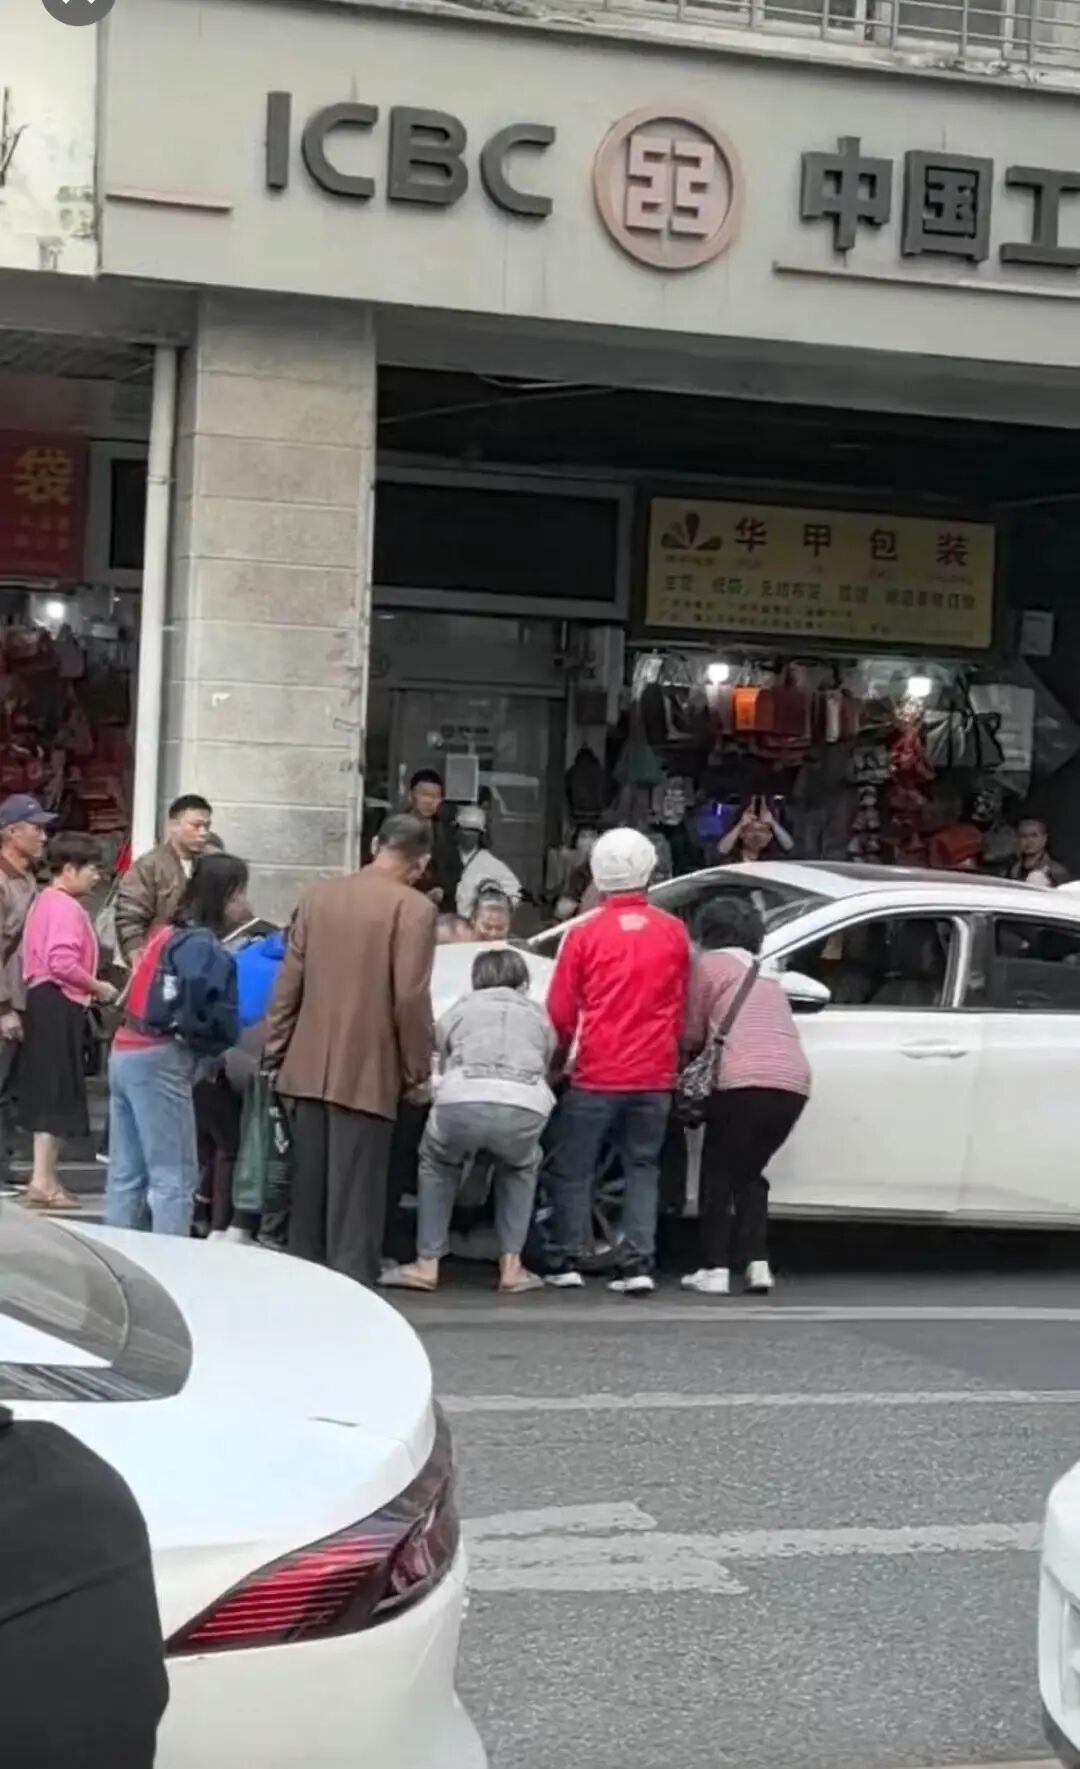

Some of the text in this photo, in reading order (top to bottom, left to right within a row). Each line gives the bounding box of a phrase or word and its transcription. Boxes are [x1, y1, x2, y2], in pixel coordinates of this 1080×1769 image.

[265, 91, 556, 218] ICBC
[800, 136, 1080, 268] 中国工
[734, 514, 969, 566] 华甲包装
